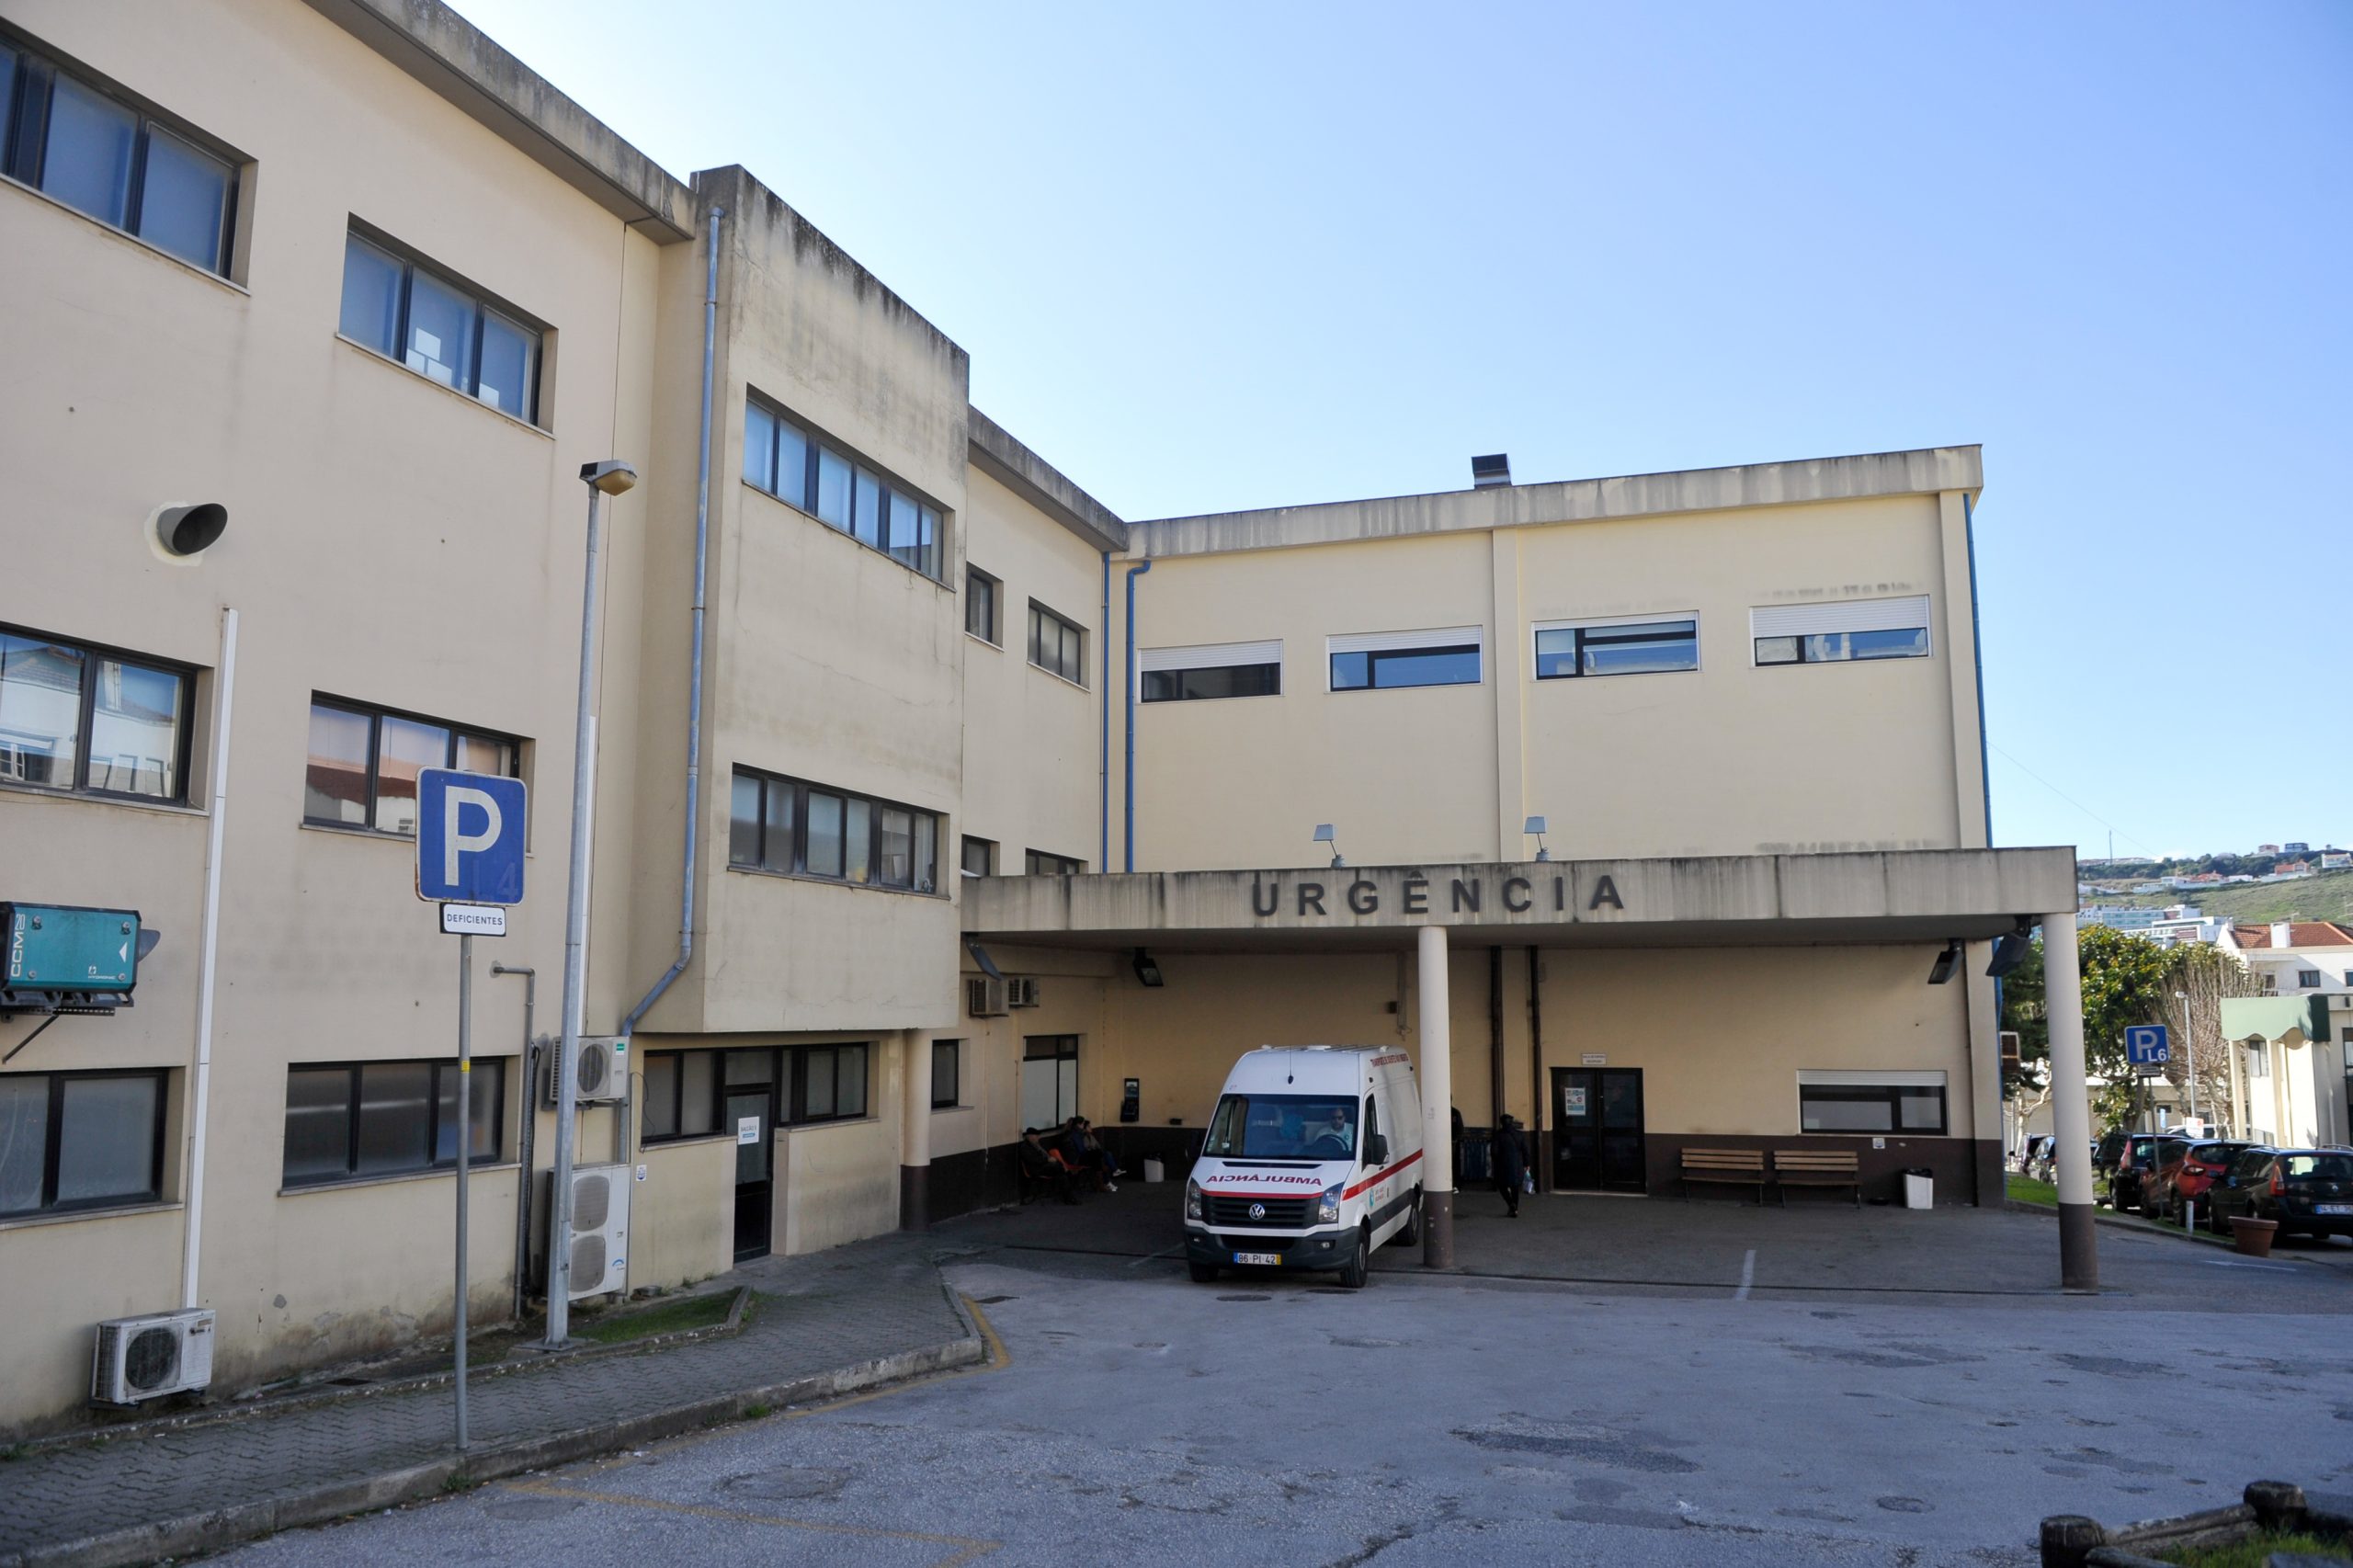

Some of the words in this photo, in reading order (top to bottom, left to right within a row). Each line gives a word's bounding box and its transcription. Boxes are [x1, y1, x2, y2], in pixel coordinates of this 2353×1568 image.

[445, 785, 502, 886] P
[1252, 870, 1625, 916] URGÊNCIA
[447, 914, 503, 926] DEFICIENTES
[2134, 1030, 2158, 1060] P
[2147, 1048, 2167, 1062] L6
